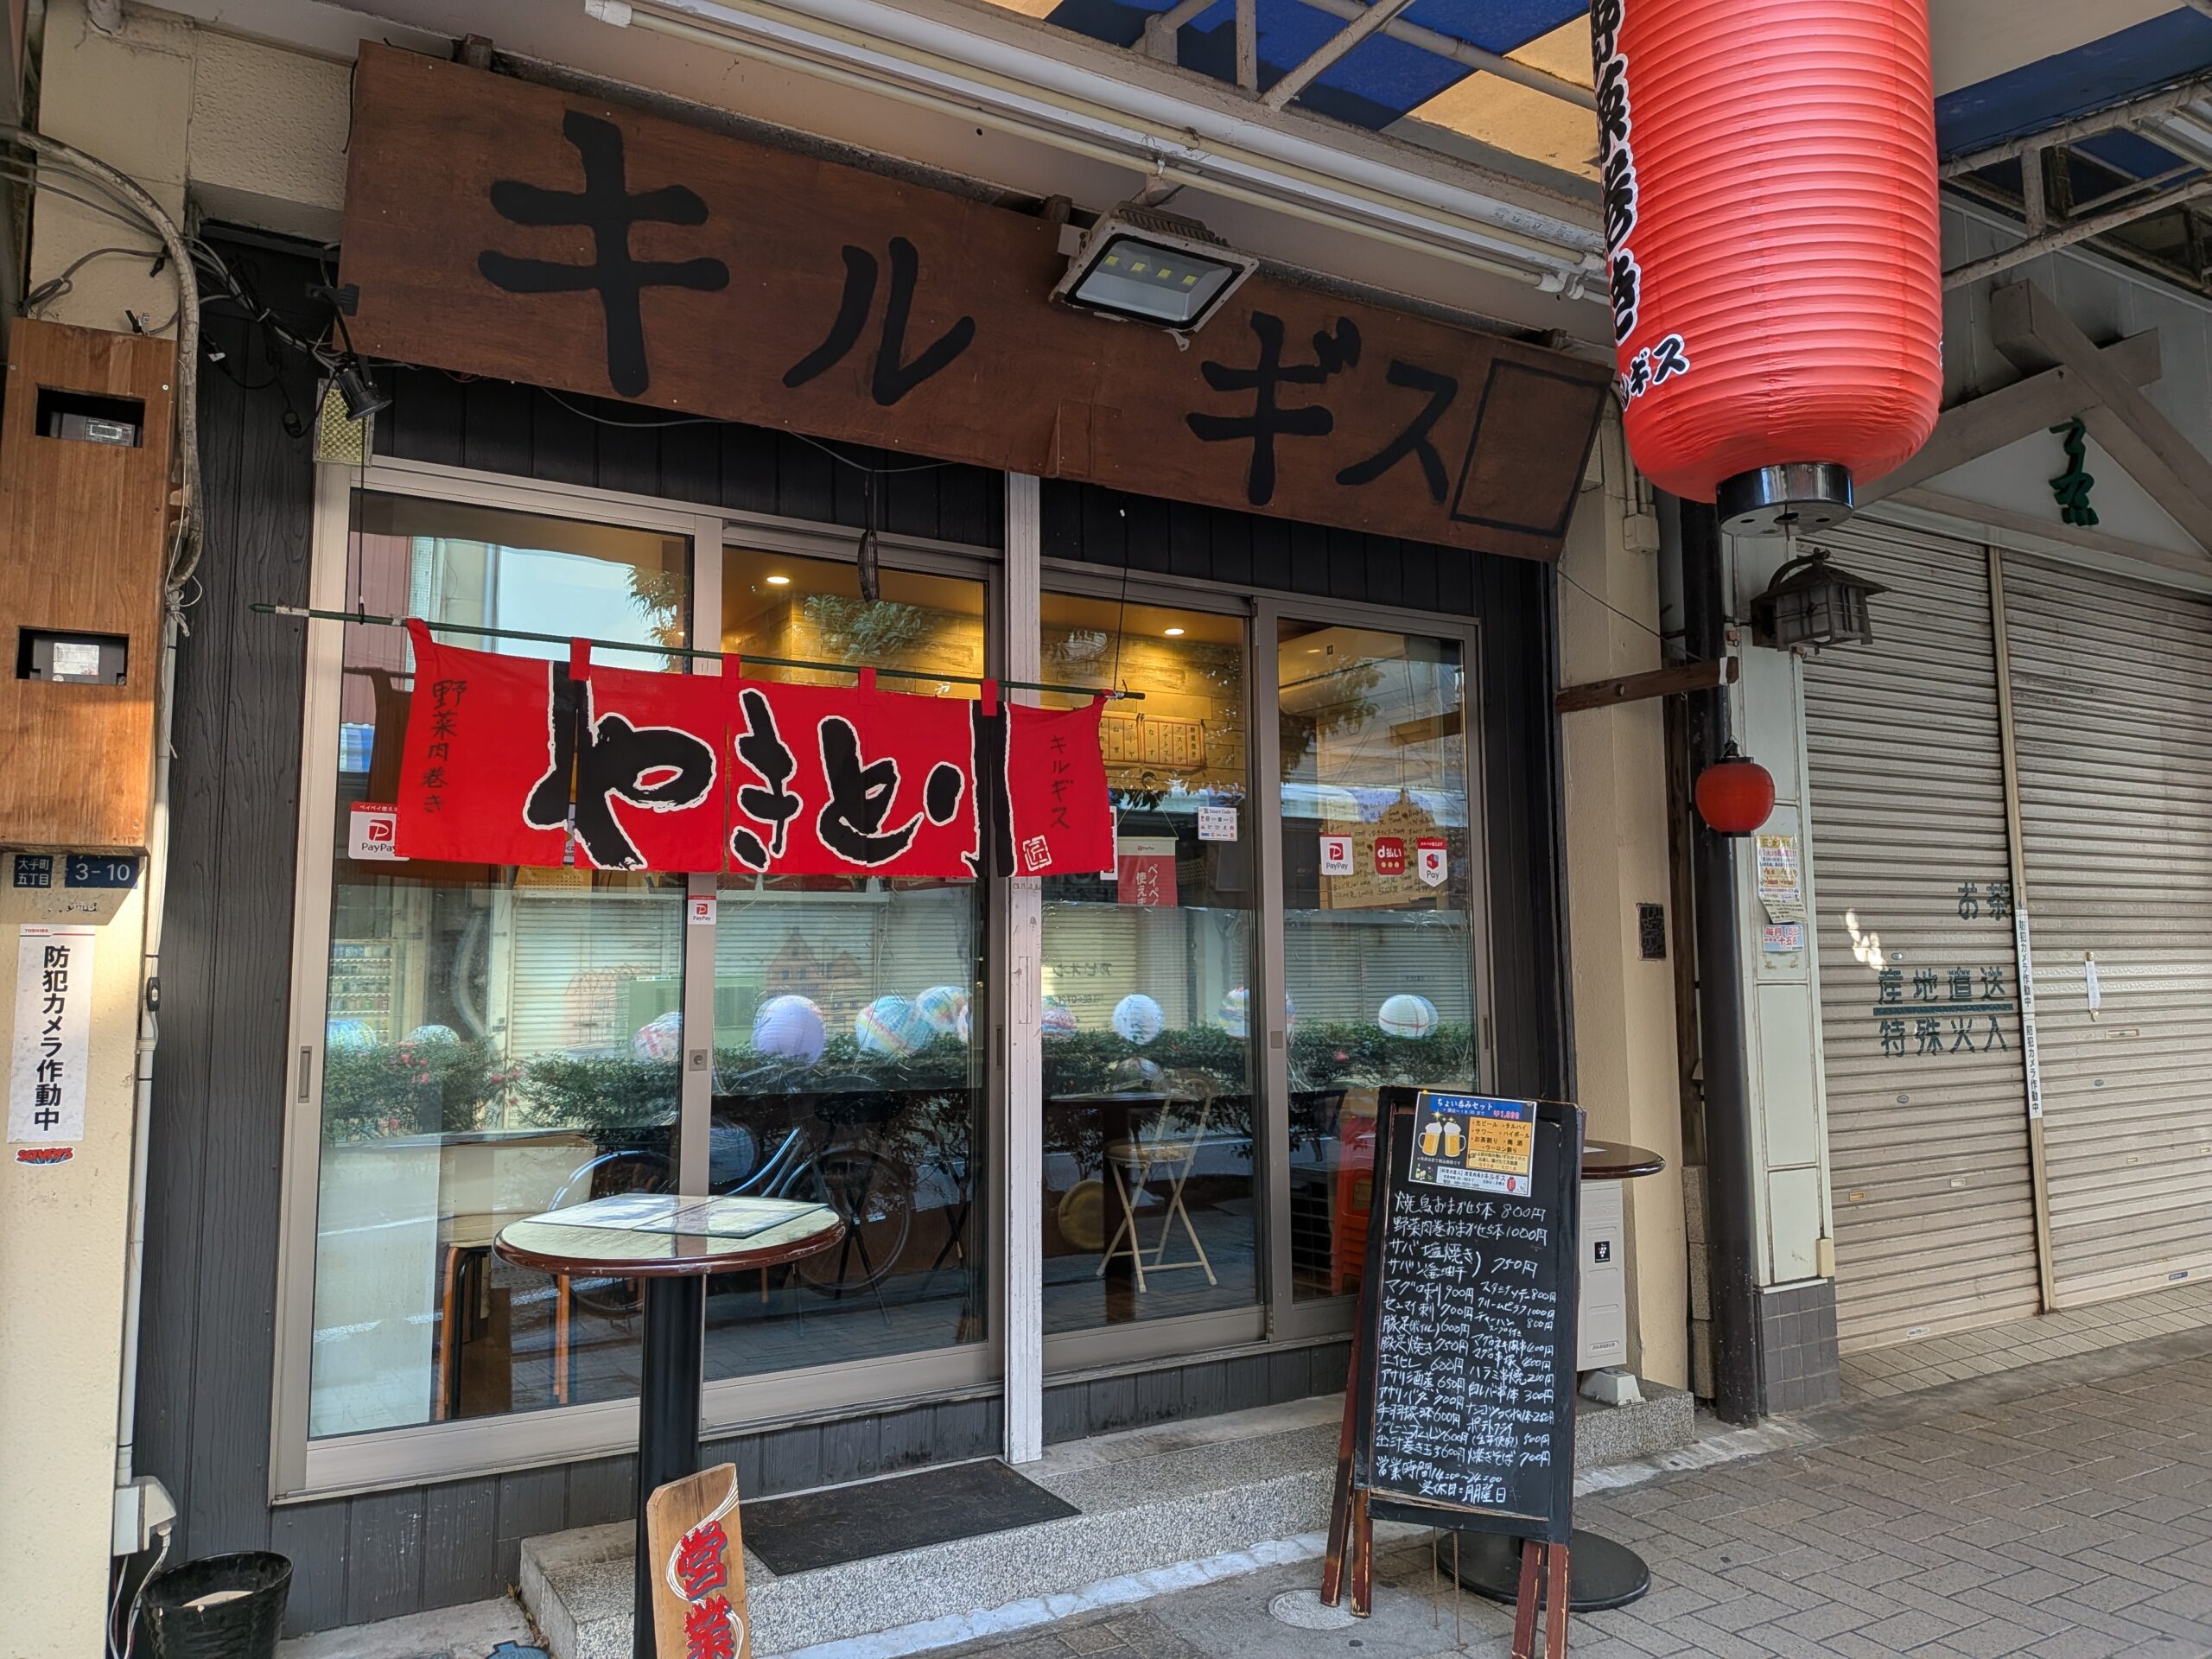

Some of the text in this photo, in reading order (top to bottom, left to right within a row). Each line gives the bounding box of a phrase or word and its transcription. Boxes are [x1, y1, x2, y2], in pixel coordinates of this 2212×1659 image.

[478, 110, 1459, 507] キルギス
[421, 678, 467, 814] 野菜肉巻き
[523, 660, 1017, 877] やきとり
[1049, 734, 1074, 830] キルギス
[1377, 845, 1402, 858] d払い
[17, 858, 49, 871] 大手町
[75, 863, 130, 882] 3-10
[17, 873, 49, 886] 五丁目
[1426, 870, 1440, 880] Pay
[2018, 919, 2031, 1007] 防犯カメラ作動中
[1878, 966, 2005, 1005] 産地直送
[34, 944, 71, 1132] 防犯カメラ作動中
[2025, 1025, 2039, 1114] 防犯カメラ作動中
[1437, 1097, 1493, 1110] ちょい呑みセット
[1501, 1204, 1546, 1222] 800円
[1506, 1226, 1548, 1246] 1000円
[1491, 1257, 1538, 1279] 750円
[1444, 1285, 1474, 1304] 900円
[1531, 1288, 1556, 1303] 800円
[1440, 1303, 1473, 1322] 700円
[1527, 1308, 1555, 1320] 1000円
[1440, 1317, 1471, 1338] 600円
[1527, 1318, 1553, 1332] 800円
[1433, 1338, 1469, 1357] 750円
[1527, 1342, 1554, 1358] 400円
[1380, 1354, 1464, 1375] エイヒレ 600円
[1522, 1356, 1551, 1372] 400円
[1437, 1376, 1465, 1395] 650円
[1527, 1373, 1554, 1388] 200円
[1433, 1394, 1465, 1411] 700円
[1524, 1389, 1554, 1404] 300円
[1433, 1406, 1460, 1428] 600円
[1443, 1428, 1469, 1445] 600円
[1523, 1433, 1550, 1447] 500円
[1441, 1444, 1465, 1463] 600円
[1468, 1446, 1551, 1468] 焼きそば 700円
